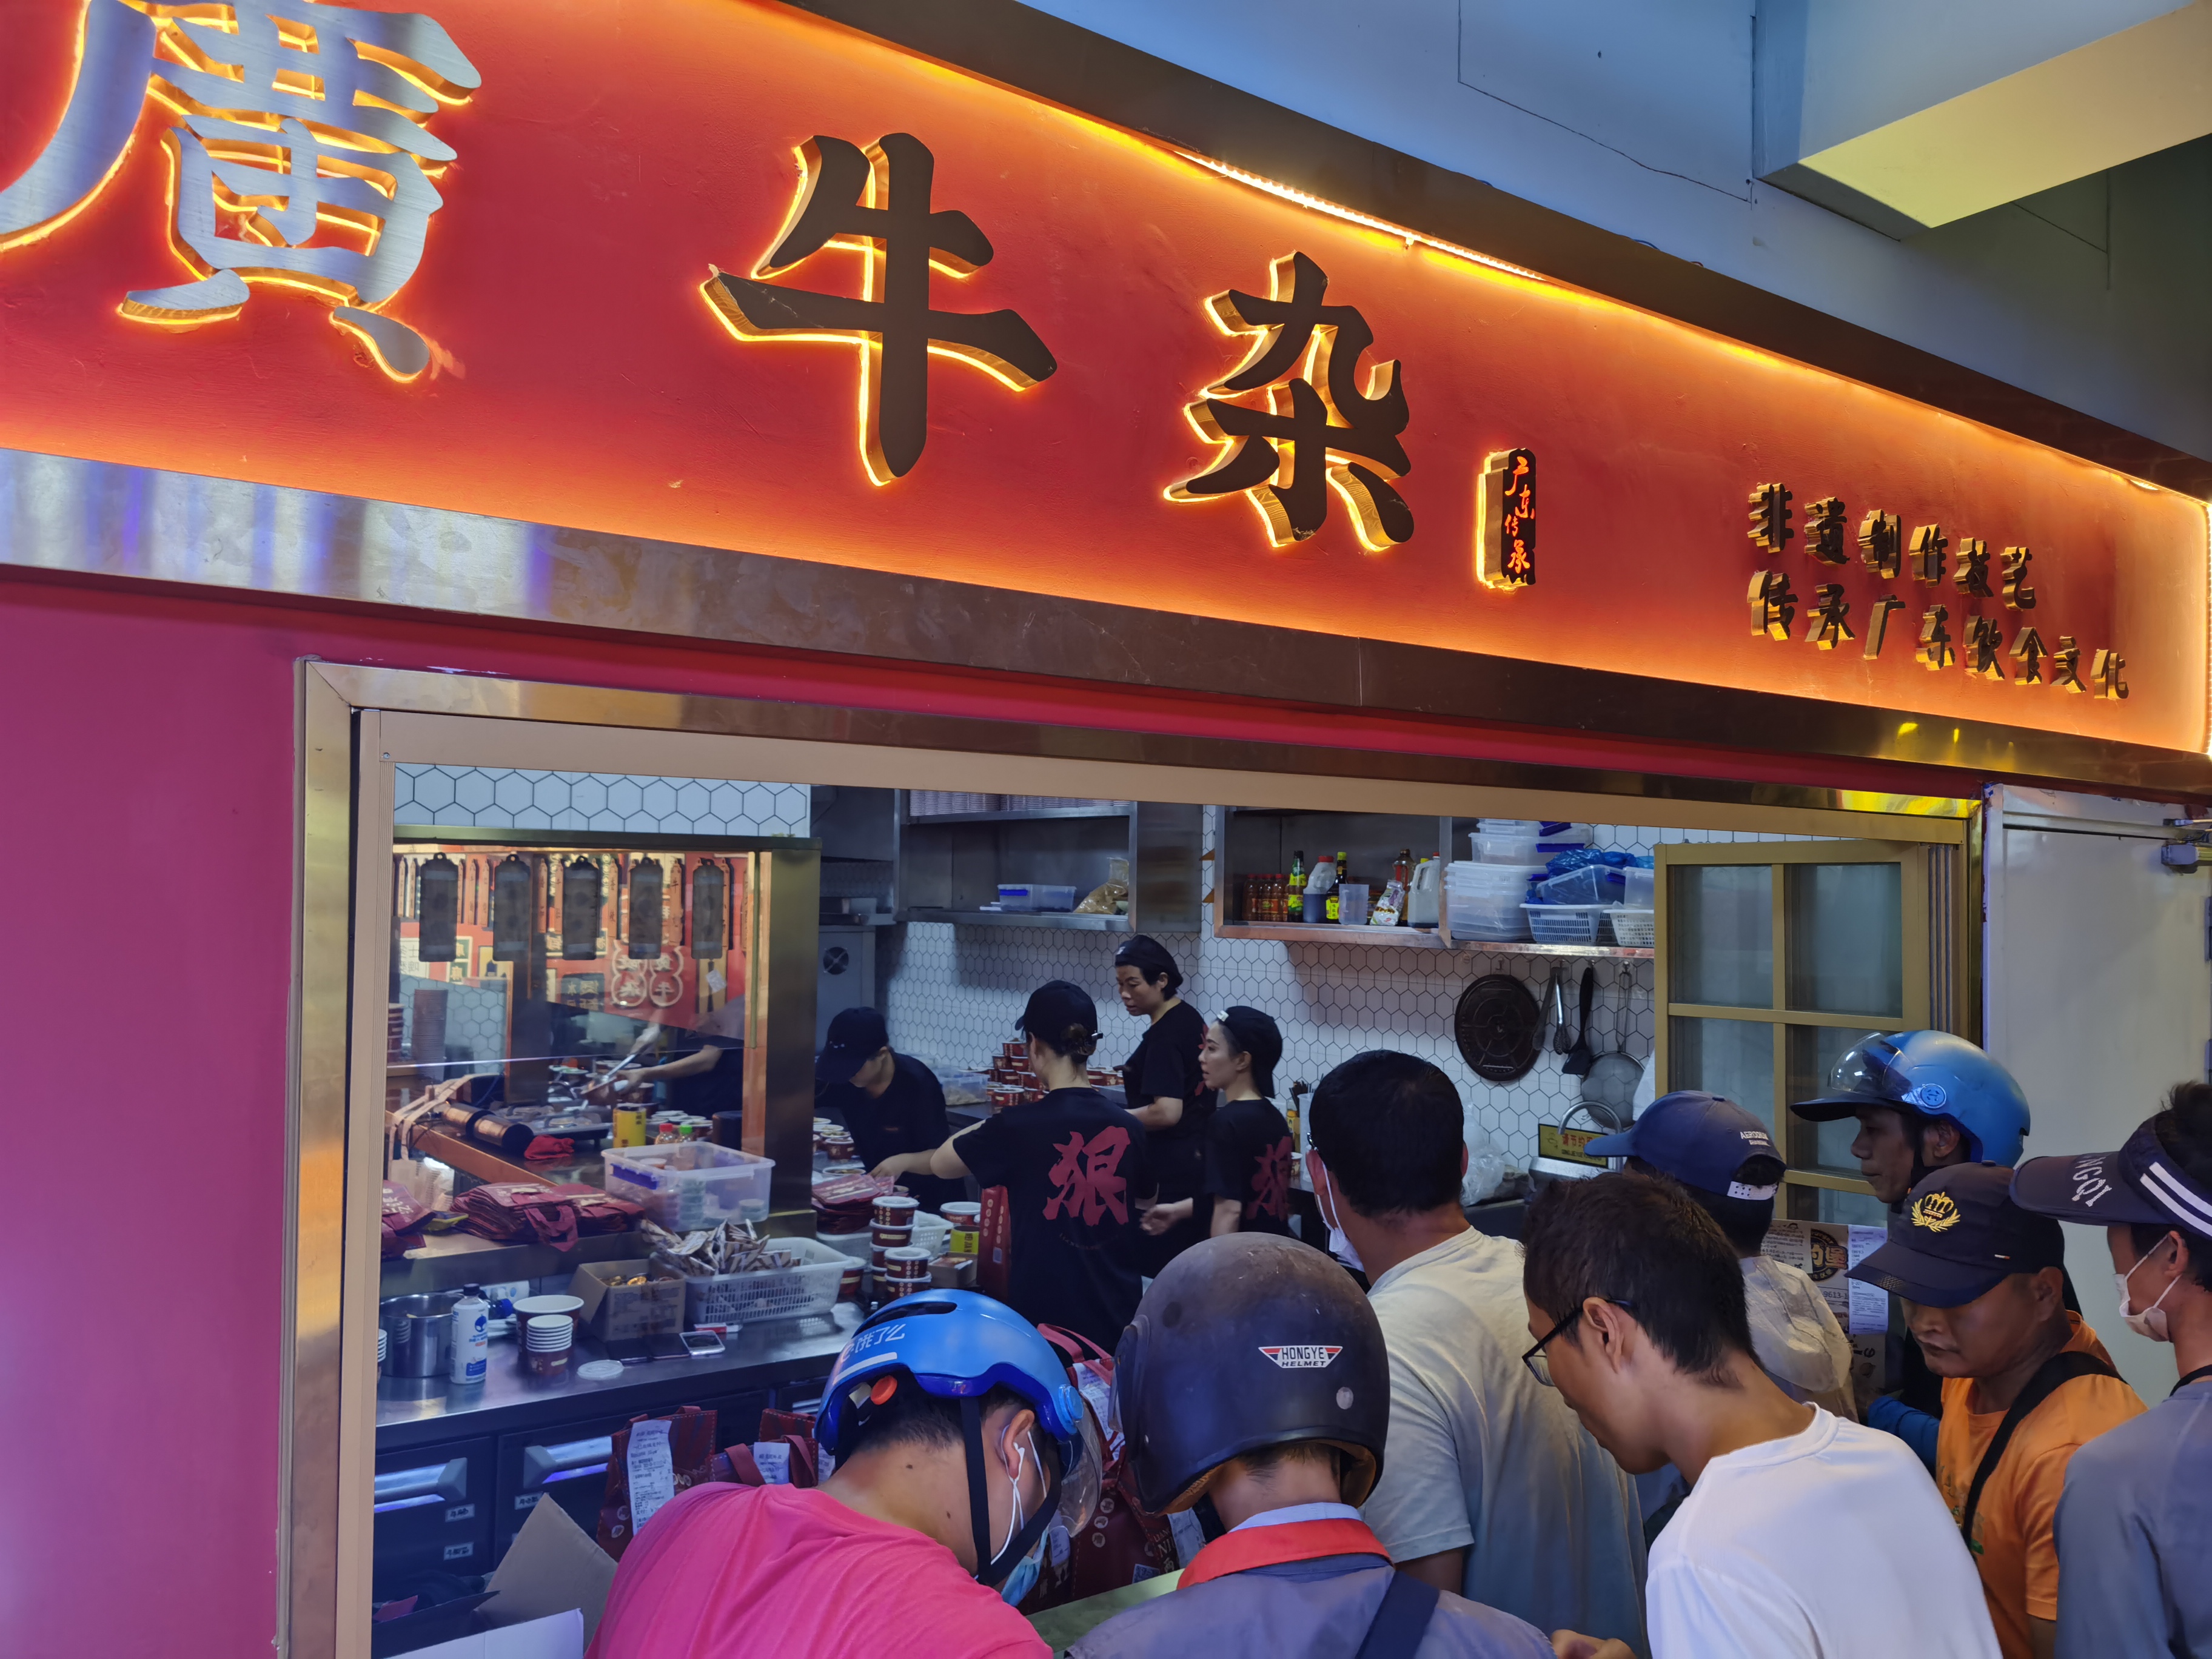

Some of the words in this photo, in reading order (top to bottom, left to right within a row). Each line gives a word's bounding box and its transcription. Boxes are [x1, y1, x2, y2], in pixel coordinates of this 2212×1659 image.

[1748, 483, 2036, 611] 非遗制作技艺
[1747, 570, 2130, 700] 传承广东饮食文化
[1042, 1125, 1131, 1226] 狠
[854, 1323, 907, 1353] 饿了么
[1281, 1347, 1325, 1360] HONGYE
